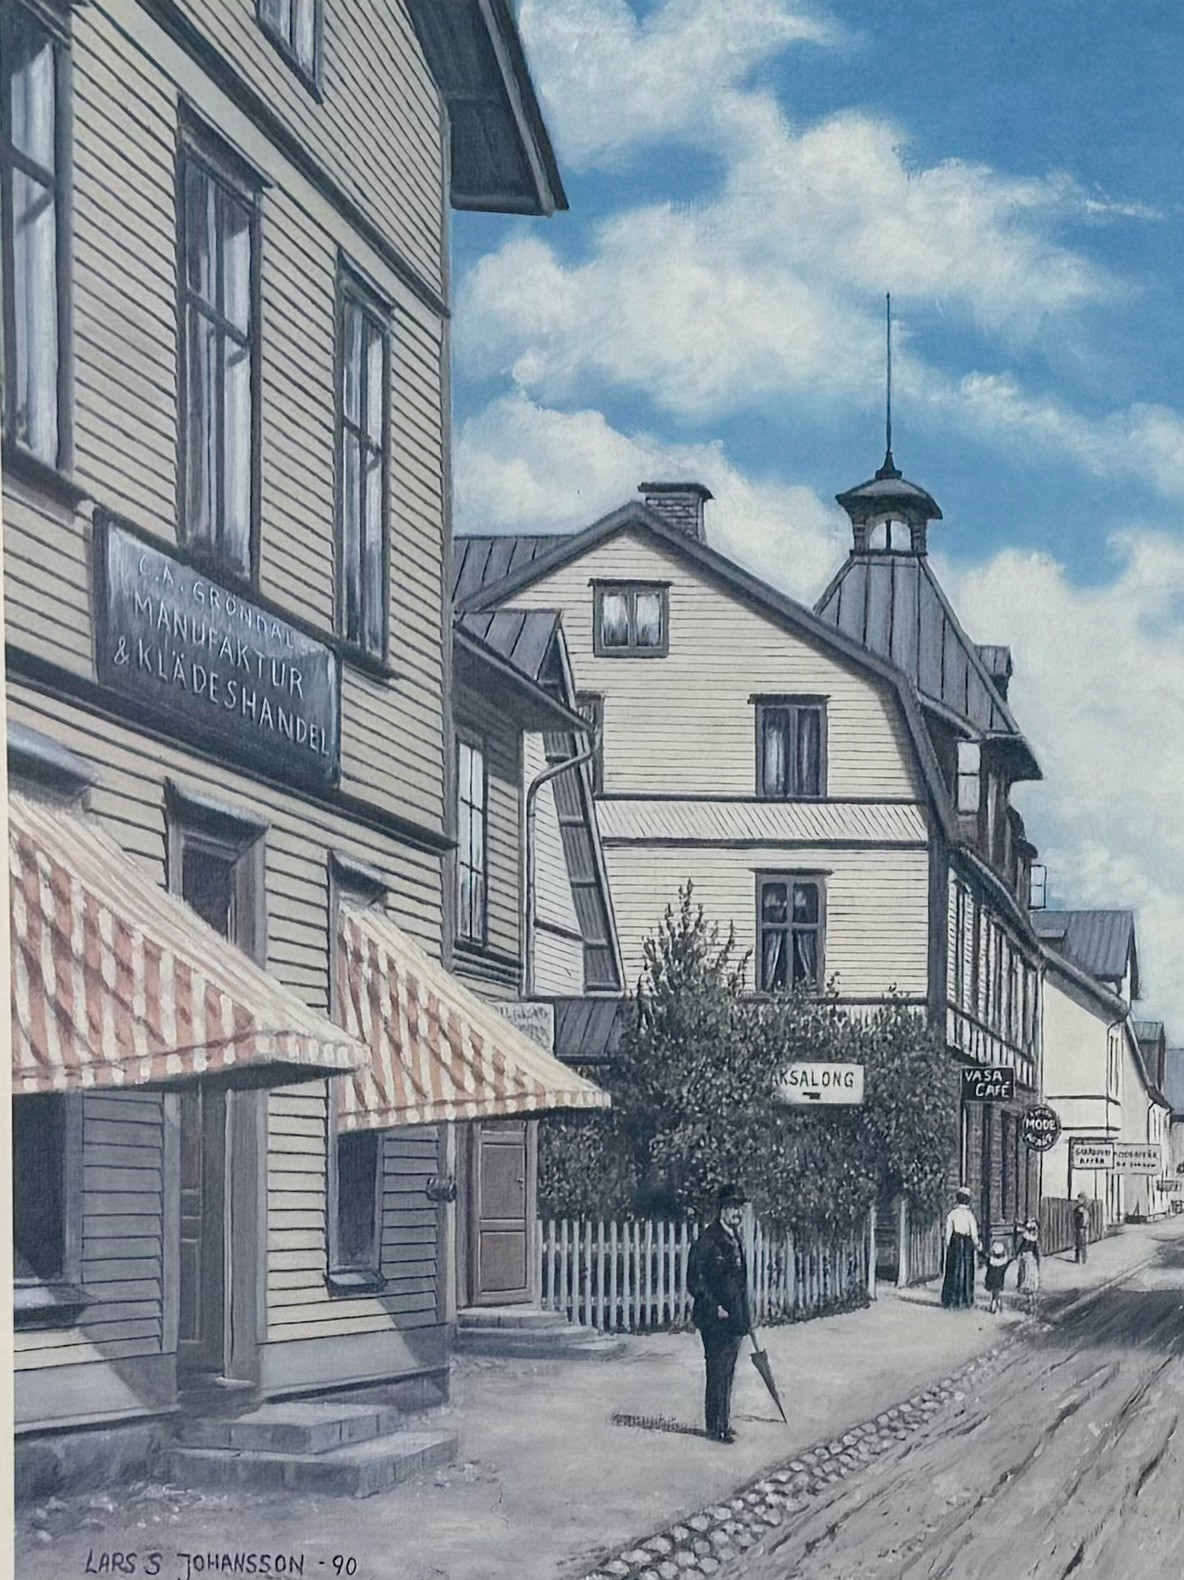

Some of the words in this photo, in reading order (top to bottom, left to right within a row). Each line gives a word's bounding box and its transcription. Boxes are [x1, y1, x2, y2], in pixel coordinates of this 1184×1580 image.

[193, 580, 295, 648] GRÖNDAL
[134, 592, 303, 698] MANUFAKTUR
[113, 635, 129, 665] &
[139, 638, 331, 757] KLÄDESHANDEL
[964, 1070, 1002, 1082] VASA
[975, 1081, 1010, 1098] CAFÉ
[1025, 1118, 1057, 1131] MODE
[85, 1549, 137, 1575] LARS
[143, 1551, 163, 1575] S
[177, 1551, 305, 1580] JOHANSSON
